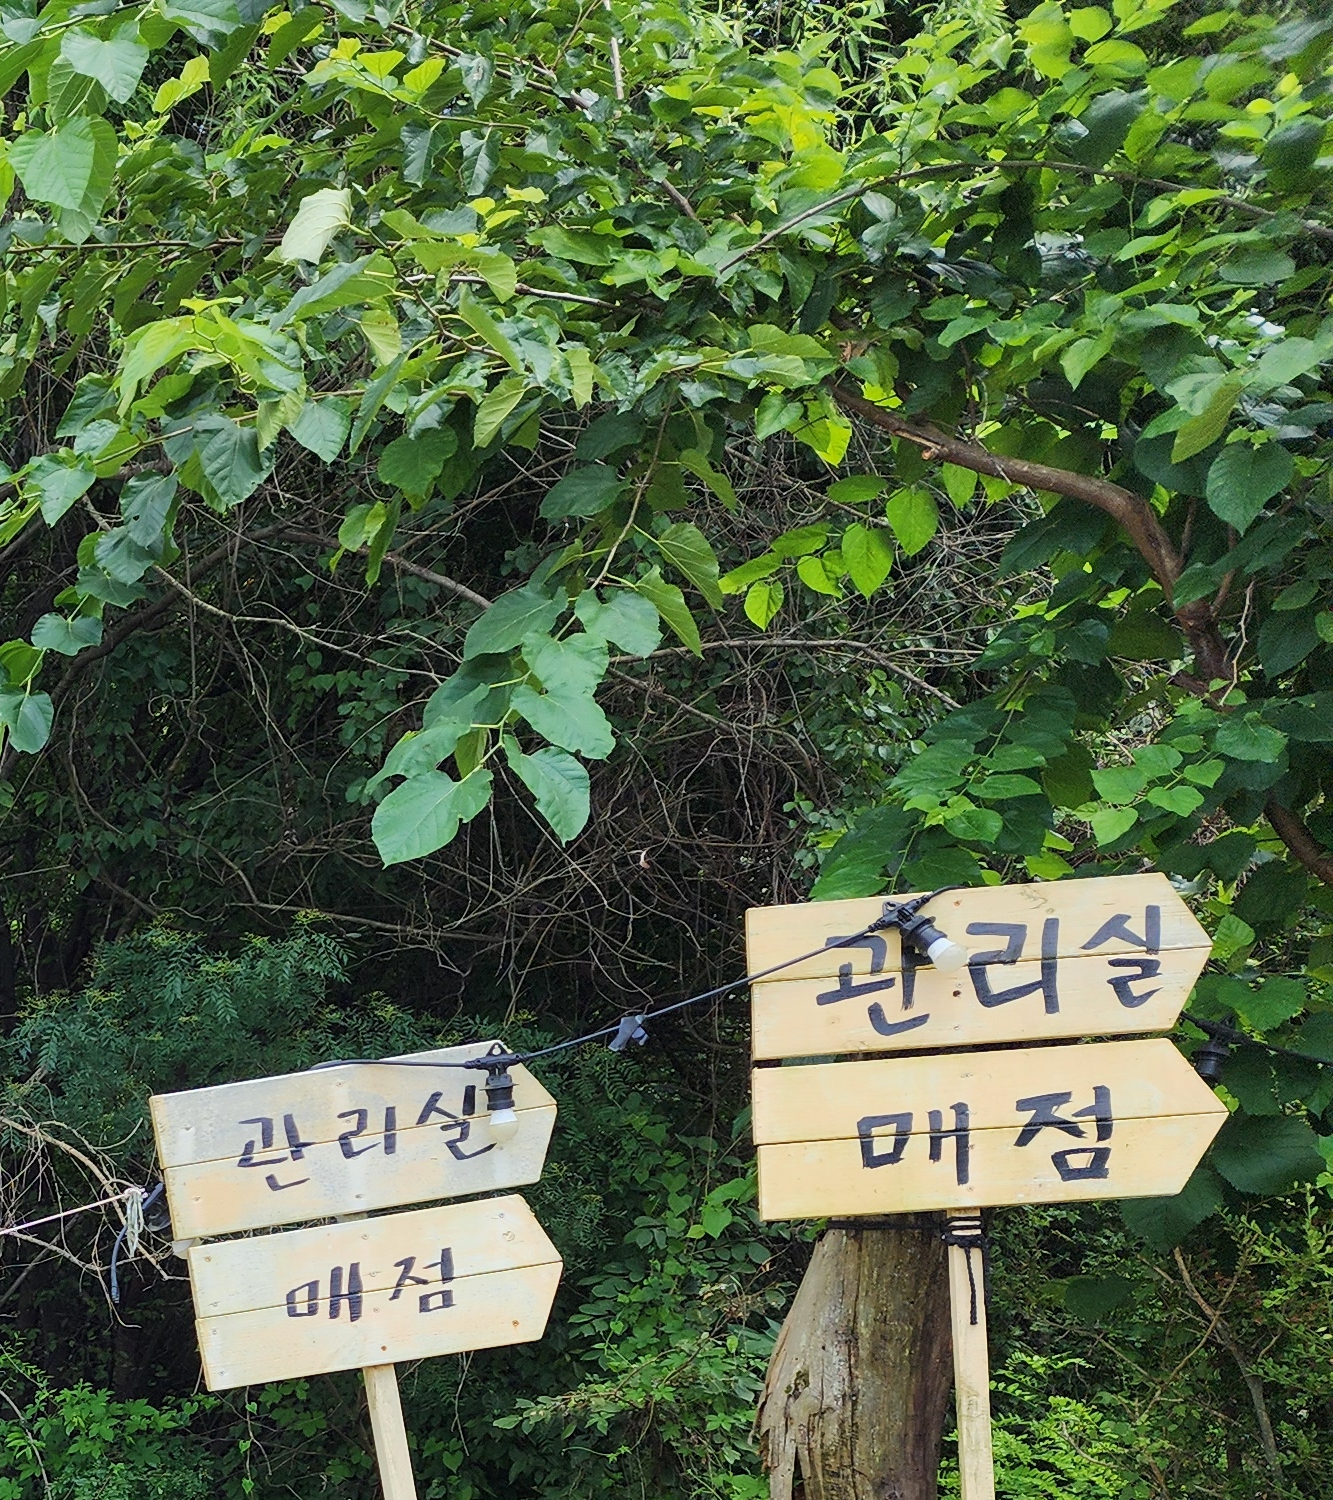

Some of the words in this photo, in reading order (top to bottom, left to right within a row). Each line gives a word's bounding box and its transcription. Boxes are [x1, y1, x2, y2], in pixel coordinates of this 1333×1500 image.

[816, 904, 1163, 1037] 관리실
[237, 1085, 499, 1192] 관리실
[857, 1084, 1113, 1186] 매점
[286, 1247, 456, 1322] 매점
